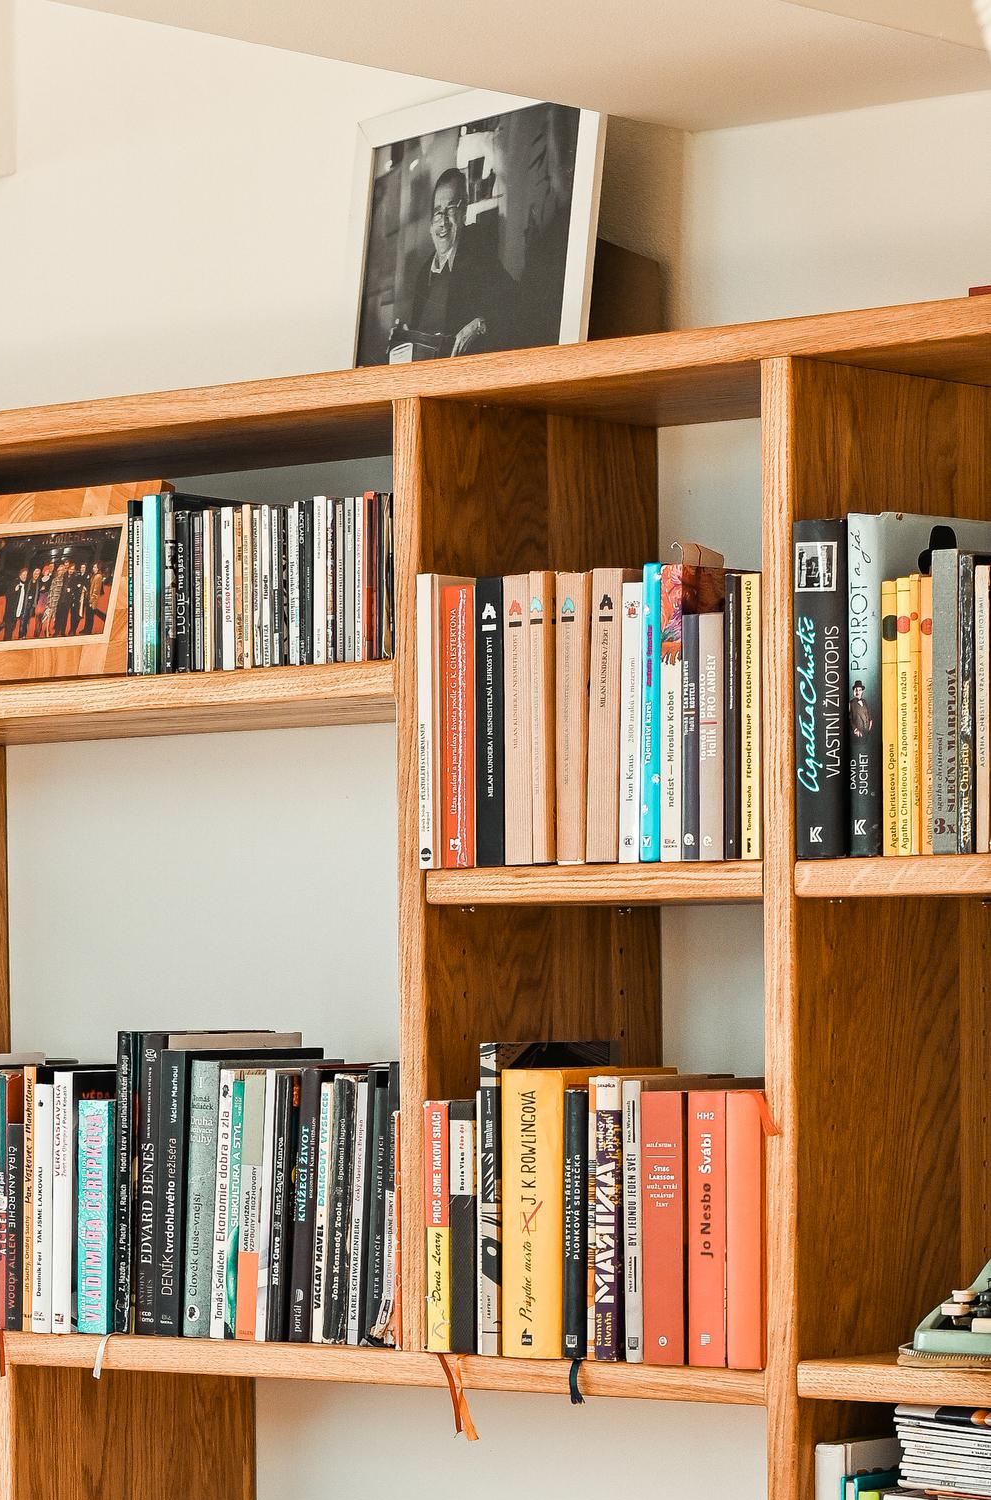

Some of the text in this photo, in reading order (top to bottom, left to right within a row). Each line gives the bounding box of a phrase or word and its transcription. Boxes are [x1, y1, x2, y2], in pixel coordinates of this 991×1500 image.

[178, 543, 183, 552] OF
[177, 592, 189, 635] LUCIE
[449, 609, 457, 669] CHESTERTONA
[850, 581, 868, 671] POIROT
[485, 686, 493, 735] NESNESITELNÁ
[796, 616, 822, 791] Agatha Christie
[823, 626, 840, 778] VLASTNÍ ŽIVOTOPIS
[486, 742, 494, 773] KUNDERA
[666, 691, 675, 807] nečíst Miroslav Krobot
[942, 668, 956, 812] SLEČNA MARPLOVÁ
[450, 773, 458, 794] radost
[486, 775, 494, 797] MILAN
[858, 753, 869, 795] SUCHET
[220, 1111, 230, 1128] zla
[697, 1112, 715, 1120] HH2
[218, 1143, 228, 1179] dobra
[430, 1111, 442, 1224] PROČ JSME TAKOVÍ SRÁČI
[697, 1133, 712, 1173] Švábi
[140, 1143, 154, 1264] EDVARD BENEŠ
[520, 1194, 537, 1205] J.
[521, 1176, 537, 1188] K.
[571, 1154, 581, 1260] PLONKOVÁ SEDMIČKA
[626, 1153, 637, 1246] BYL JEDNOU JEDEN SVĚT
[160, 1138, 176, 1295] DENÍK tvrdohlavého režiséra
[216, 1183, 227, 1242] Ekonomie
[700, 1183, 714, 1259] Jo Nesbø
[8, 1234, 16, 1268] ALLEN
[430, 1232, 442, 1302] Denis Leary
[214, 1250, 225, 1320] Tomáš Sedláček
[519, 1276, 535, 1322] Prázdné
